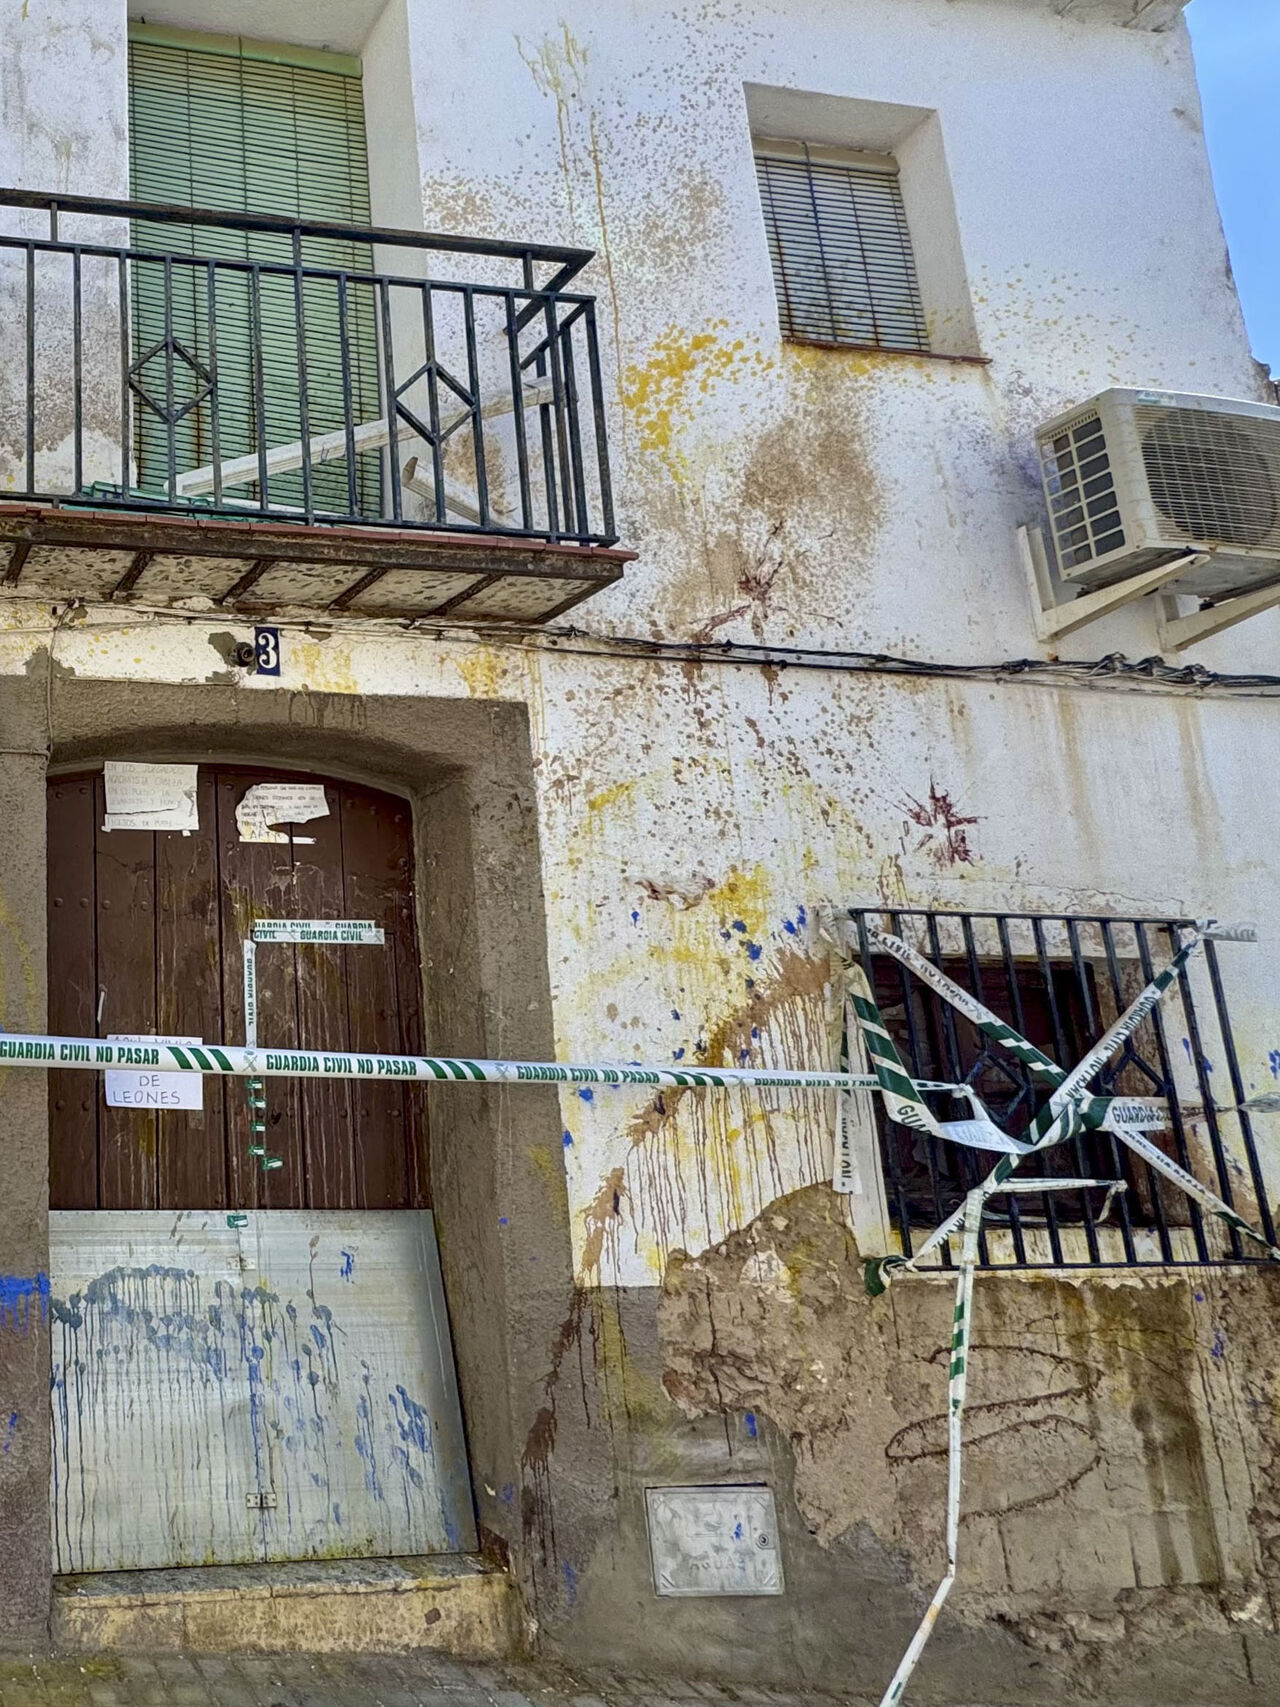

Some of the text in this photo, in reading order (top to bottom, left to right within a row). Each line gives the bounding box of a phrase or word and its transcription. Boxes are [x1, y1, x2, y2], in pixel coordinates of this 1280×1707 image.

[258, 632, 277, 669] 3
[300, 930, 338, 941] GUARDIA
[341, 931, 364, 941] CIVIL
[0, 1040, 160, 1065] GUARDIA CIVIL NO PASAR
[265, 1054, 418, 1076] GUARDIA CIVIL NO PASAR
[516, 1065, 661, 1084] GUARDIA CIVIL NO PASAR
[139, 1074, 161, 1087] DE
[113, 1089, 181, 1105] LEONES
